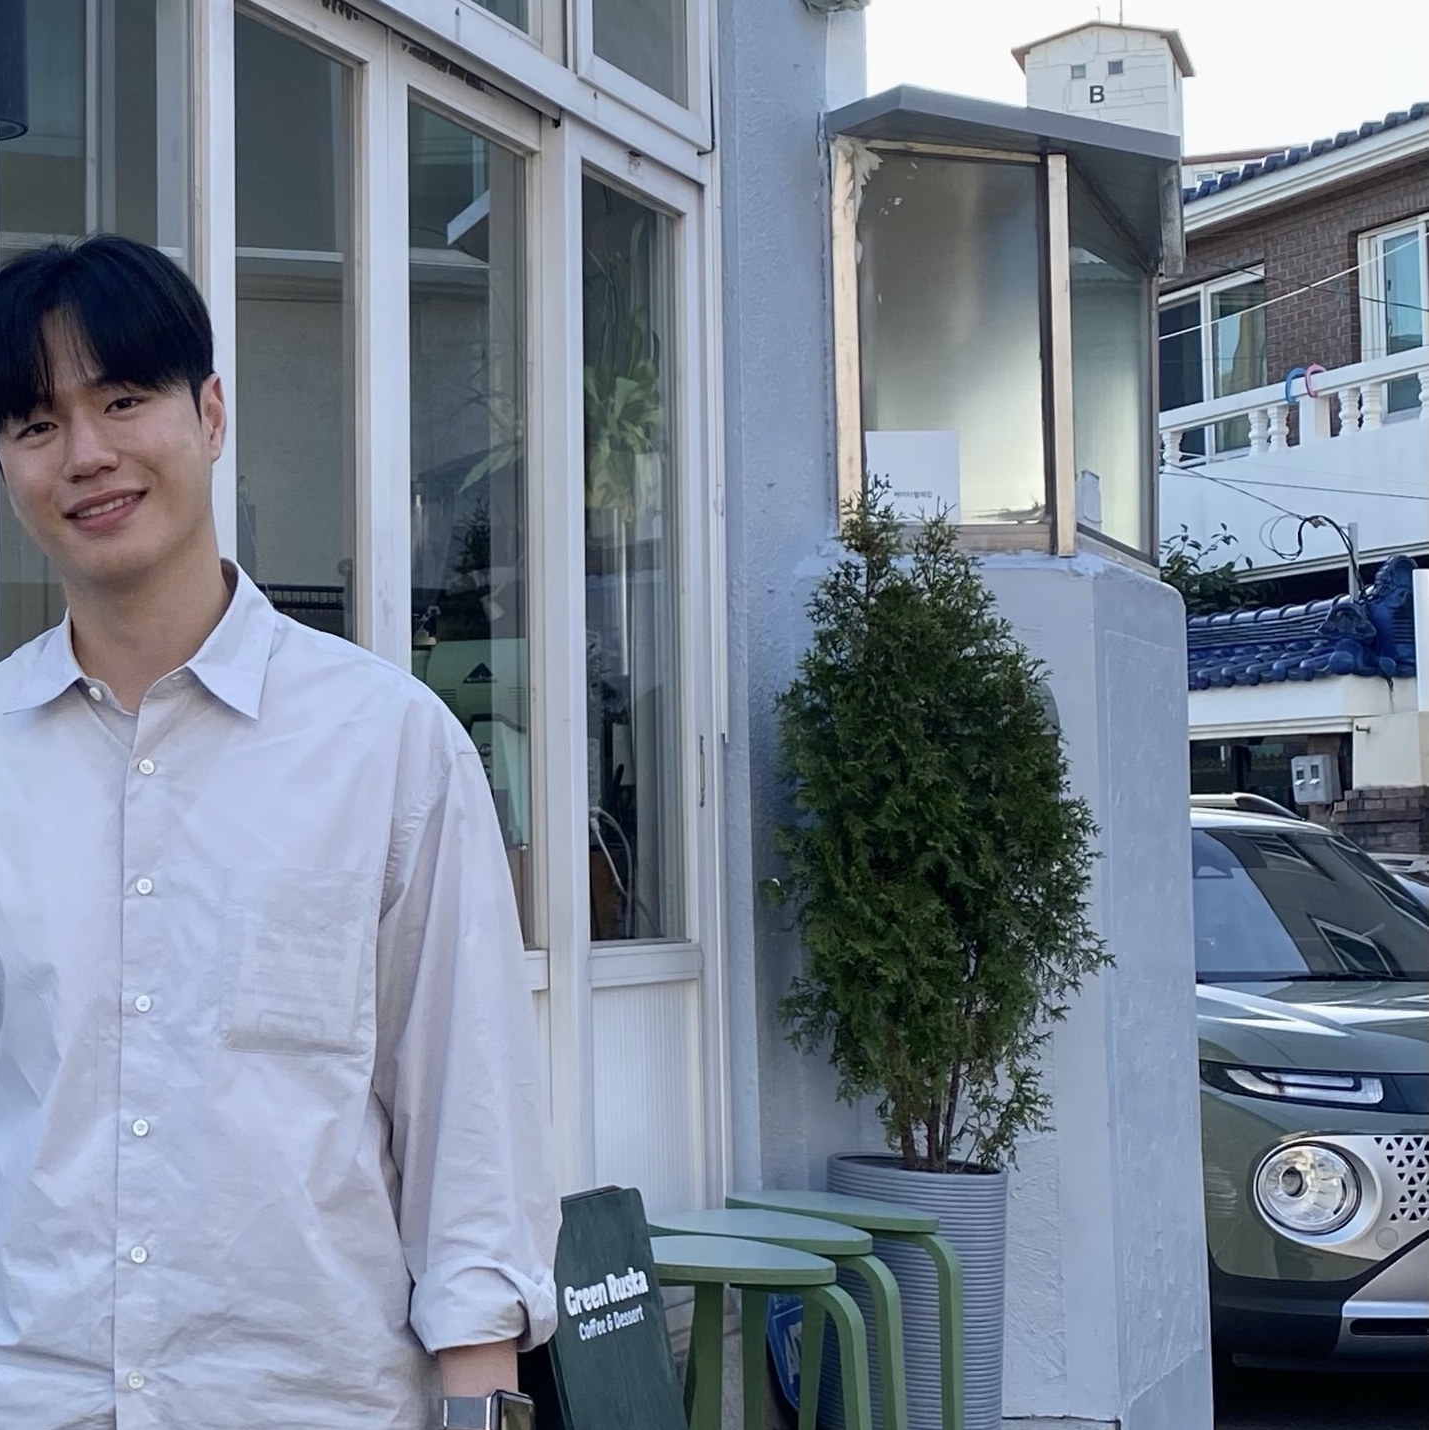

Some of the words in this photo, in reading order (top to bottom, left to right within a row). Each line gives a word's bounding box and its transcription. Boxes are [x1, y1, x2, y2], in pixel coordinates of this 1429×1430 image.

[1089, 85, 1105, 104] B
[564, 1282, 609, 1317] Green
[606, 1267, 649, 1303] Ruska
[579, 1318, 607, 1341] Coffee
[606, 1313, 614, 1332] &
[613, 1304, 644, 1329] Dessert
